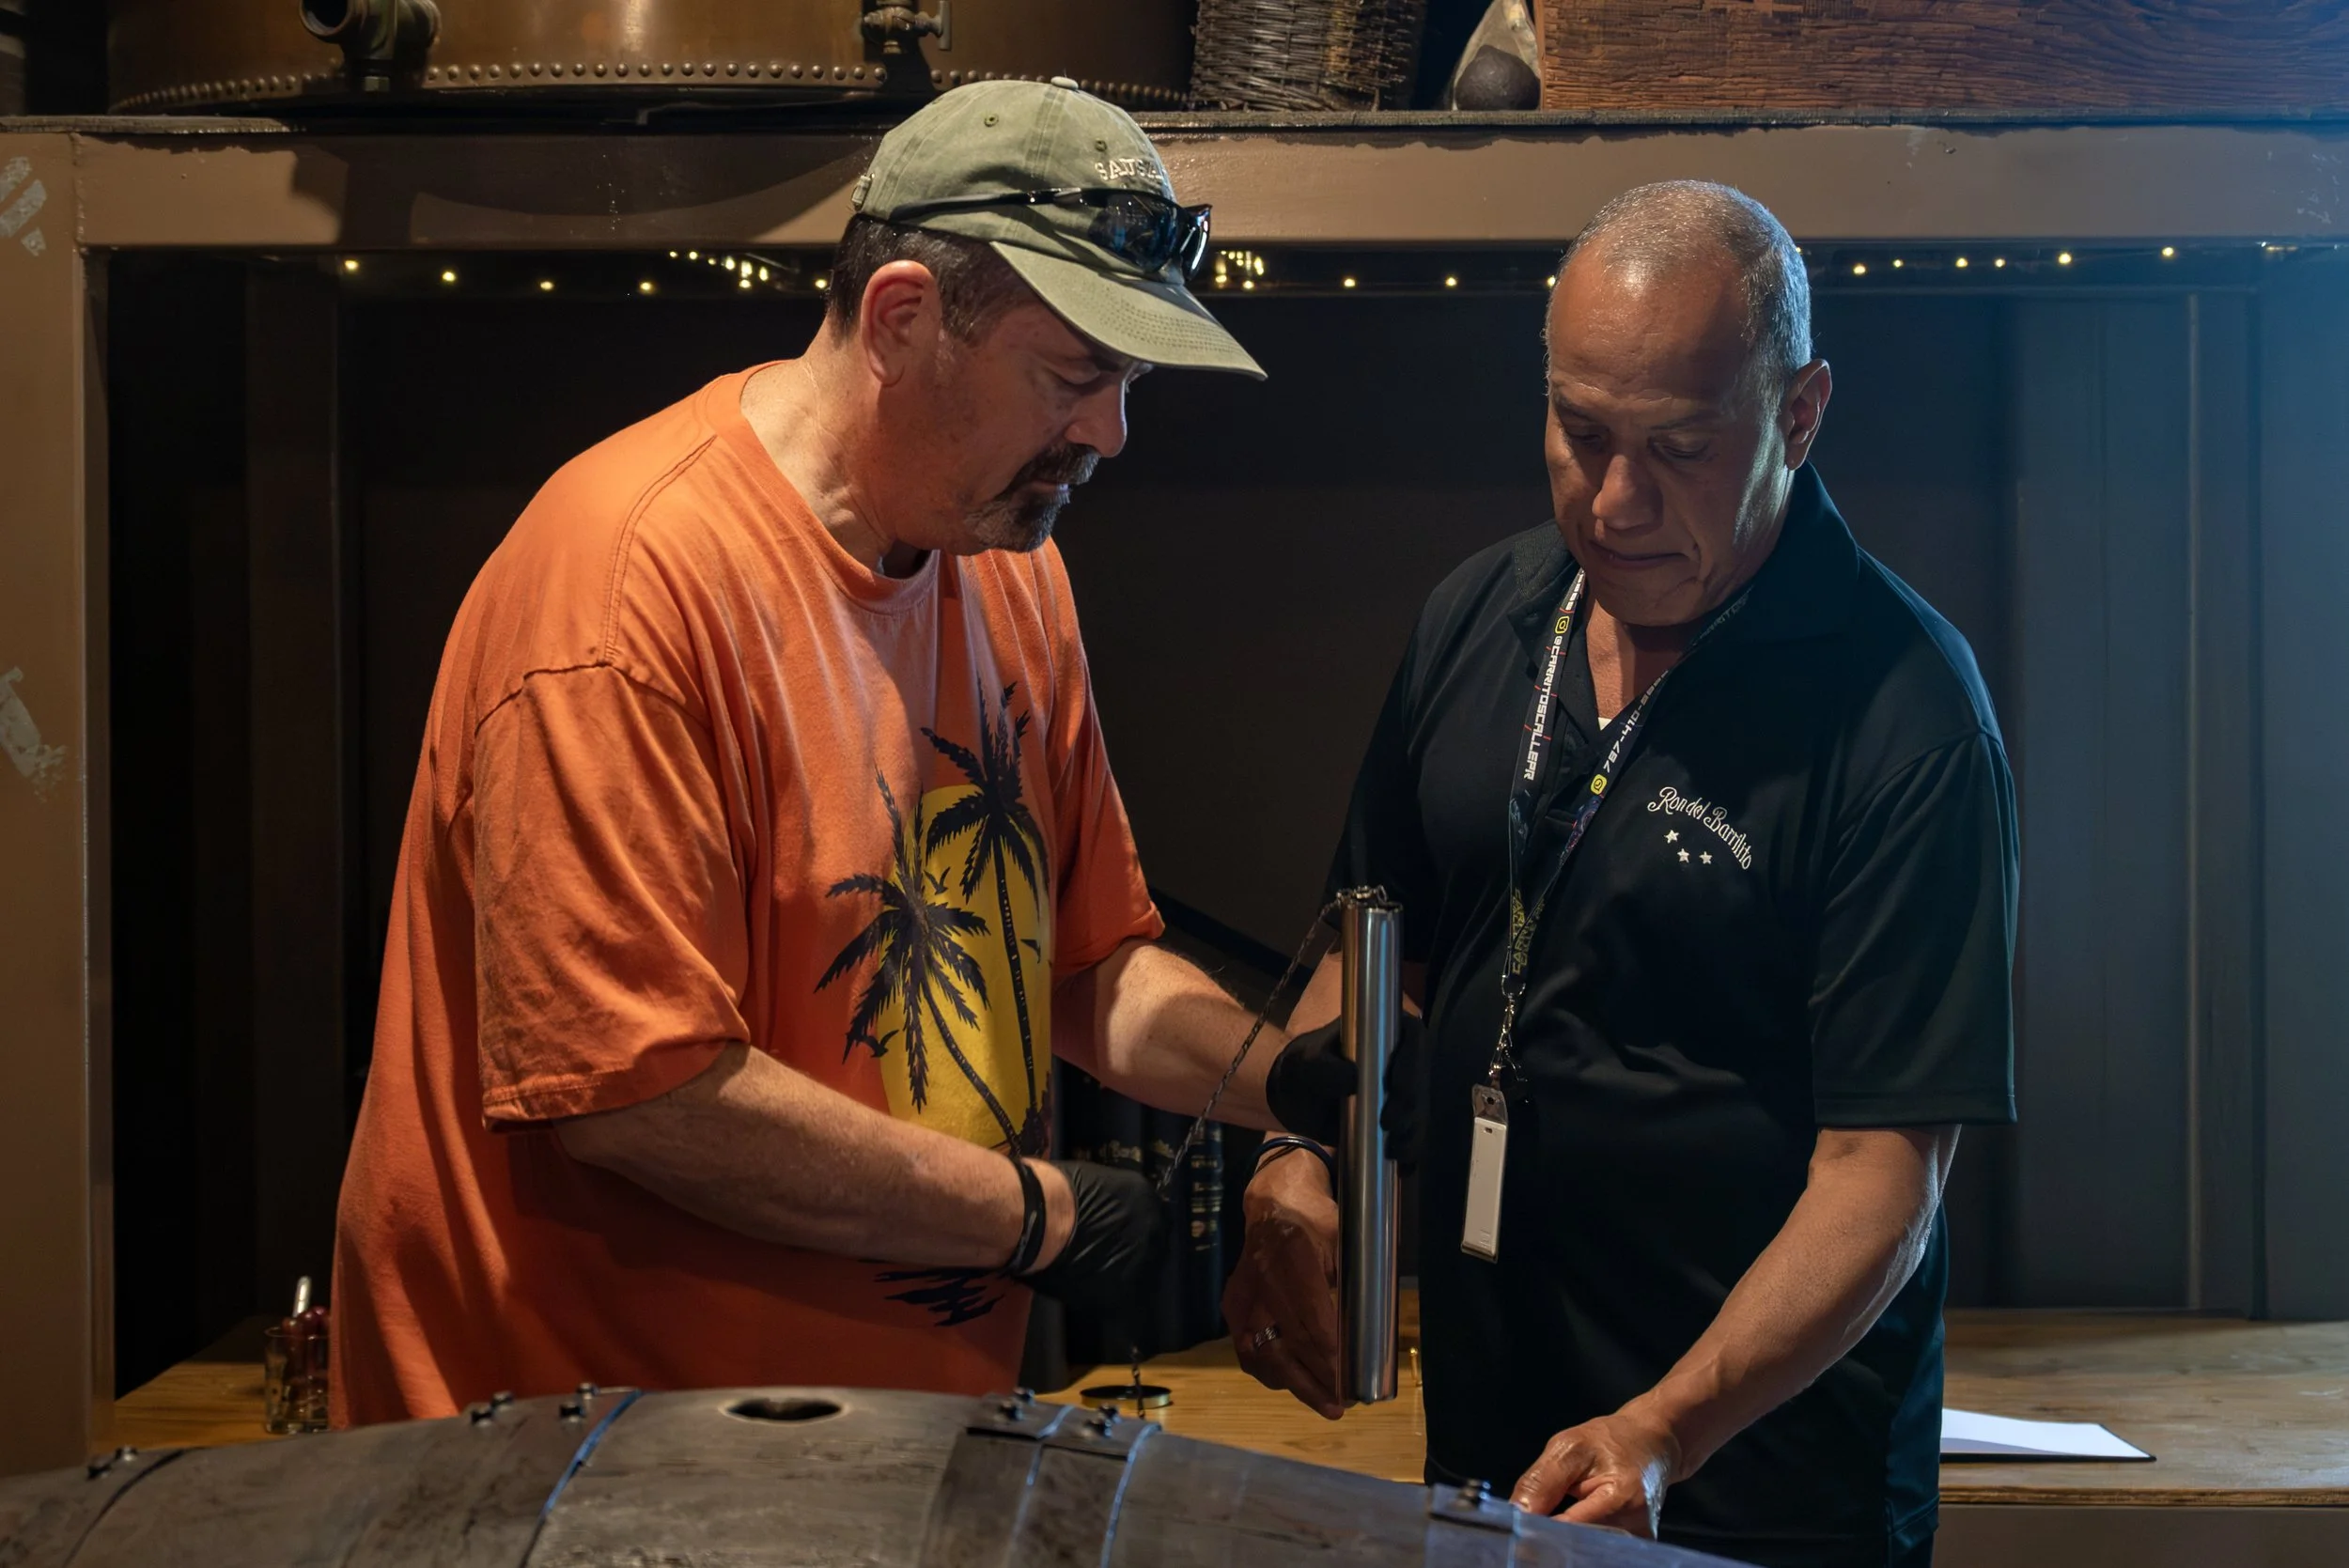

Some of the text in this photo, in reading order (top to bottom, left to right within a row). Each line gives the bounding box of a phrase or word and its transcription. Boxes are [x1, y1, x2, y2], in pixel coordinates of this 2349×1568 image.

[1524, 635, 1563, 781] @CARRITOSCALLEPR
[1603, 670, 1669, 773] 787-410-
[1647, 786, 1752, 870] Ron del Barrilito
